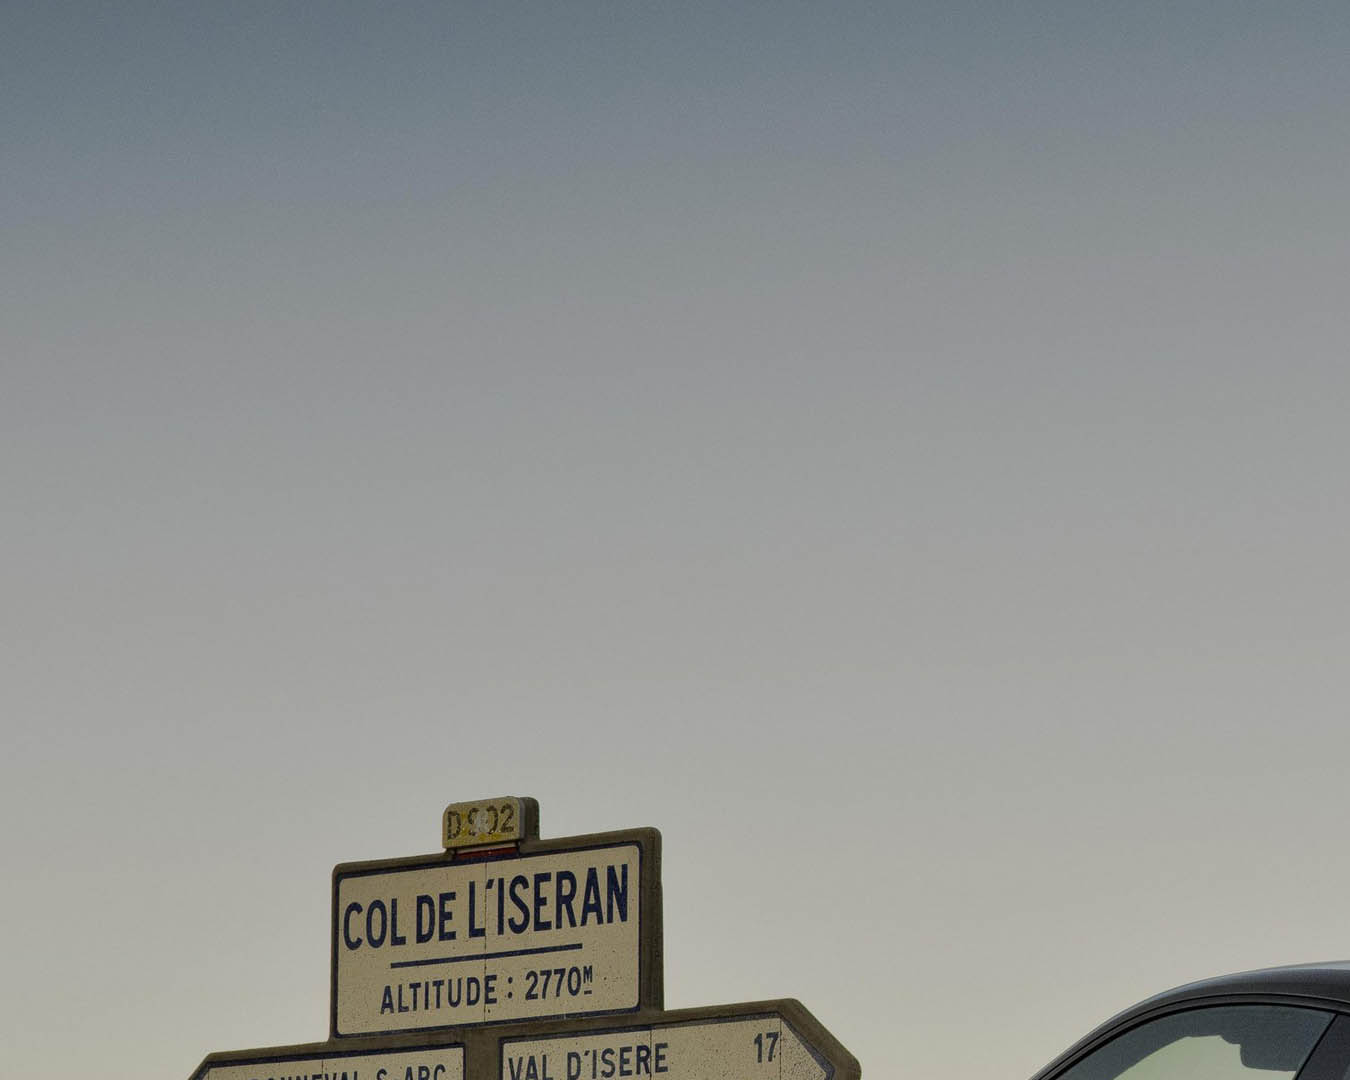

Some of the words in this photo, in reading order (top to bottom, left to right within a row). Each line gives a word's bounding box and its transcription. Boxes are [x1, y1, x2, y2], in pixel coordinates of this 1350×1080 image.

[343, 898, 406, 951] COL
[416, 891, 457, 944] DE
[468, 863, 628, 938] L'ISERAN
[380, 974, 498, 1015] ALTITUDE
[754, 1032, 779, 1063] 17
